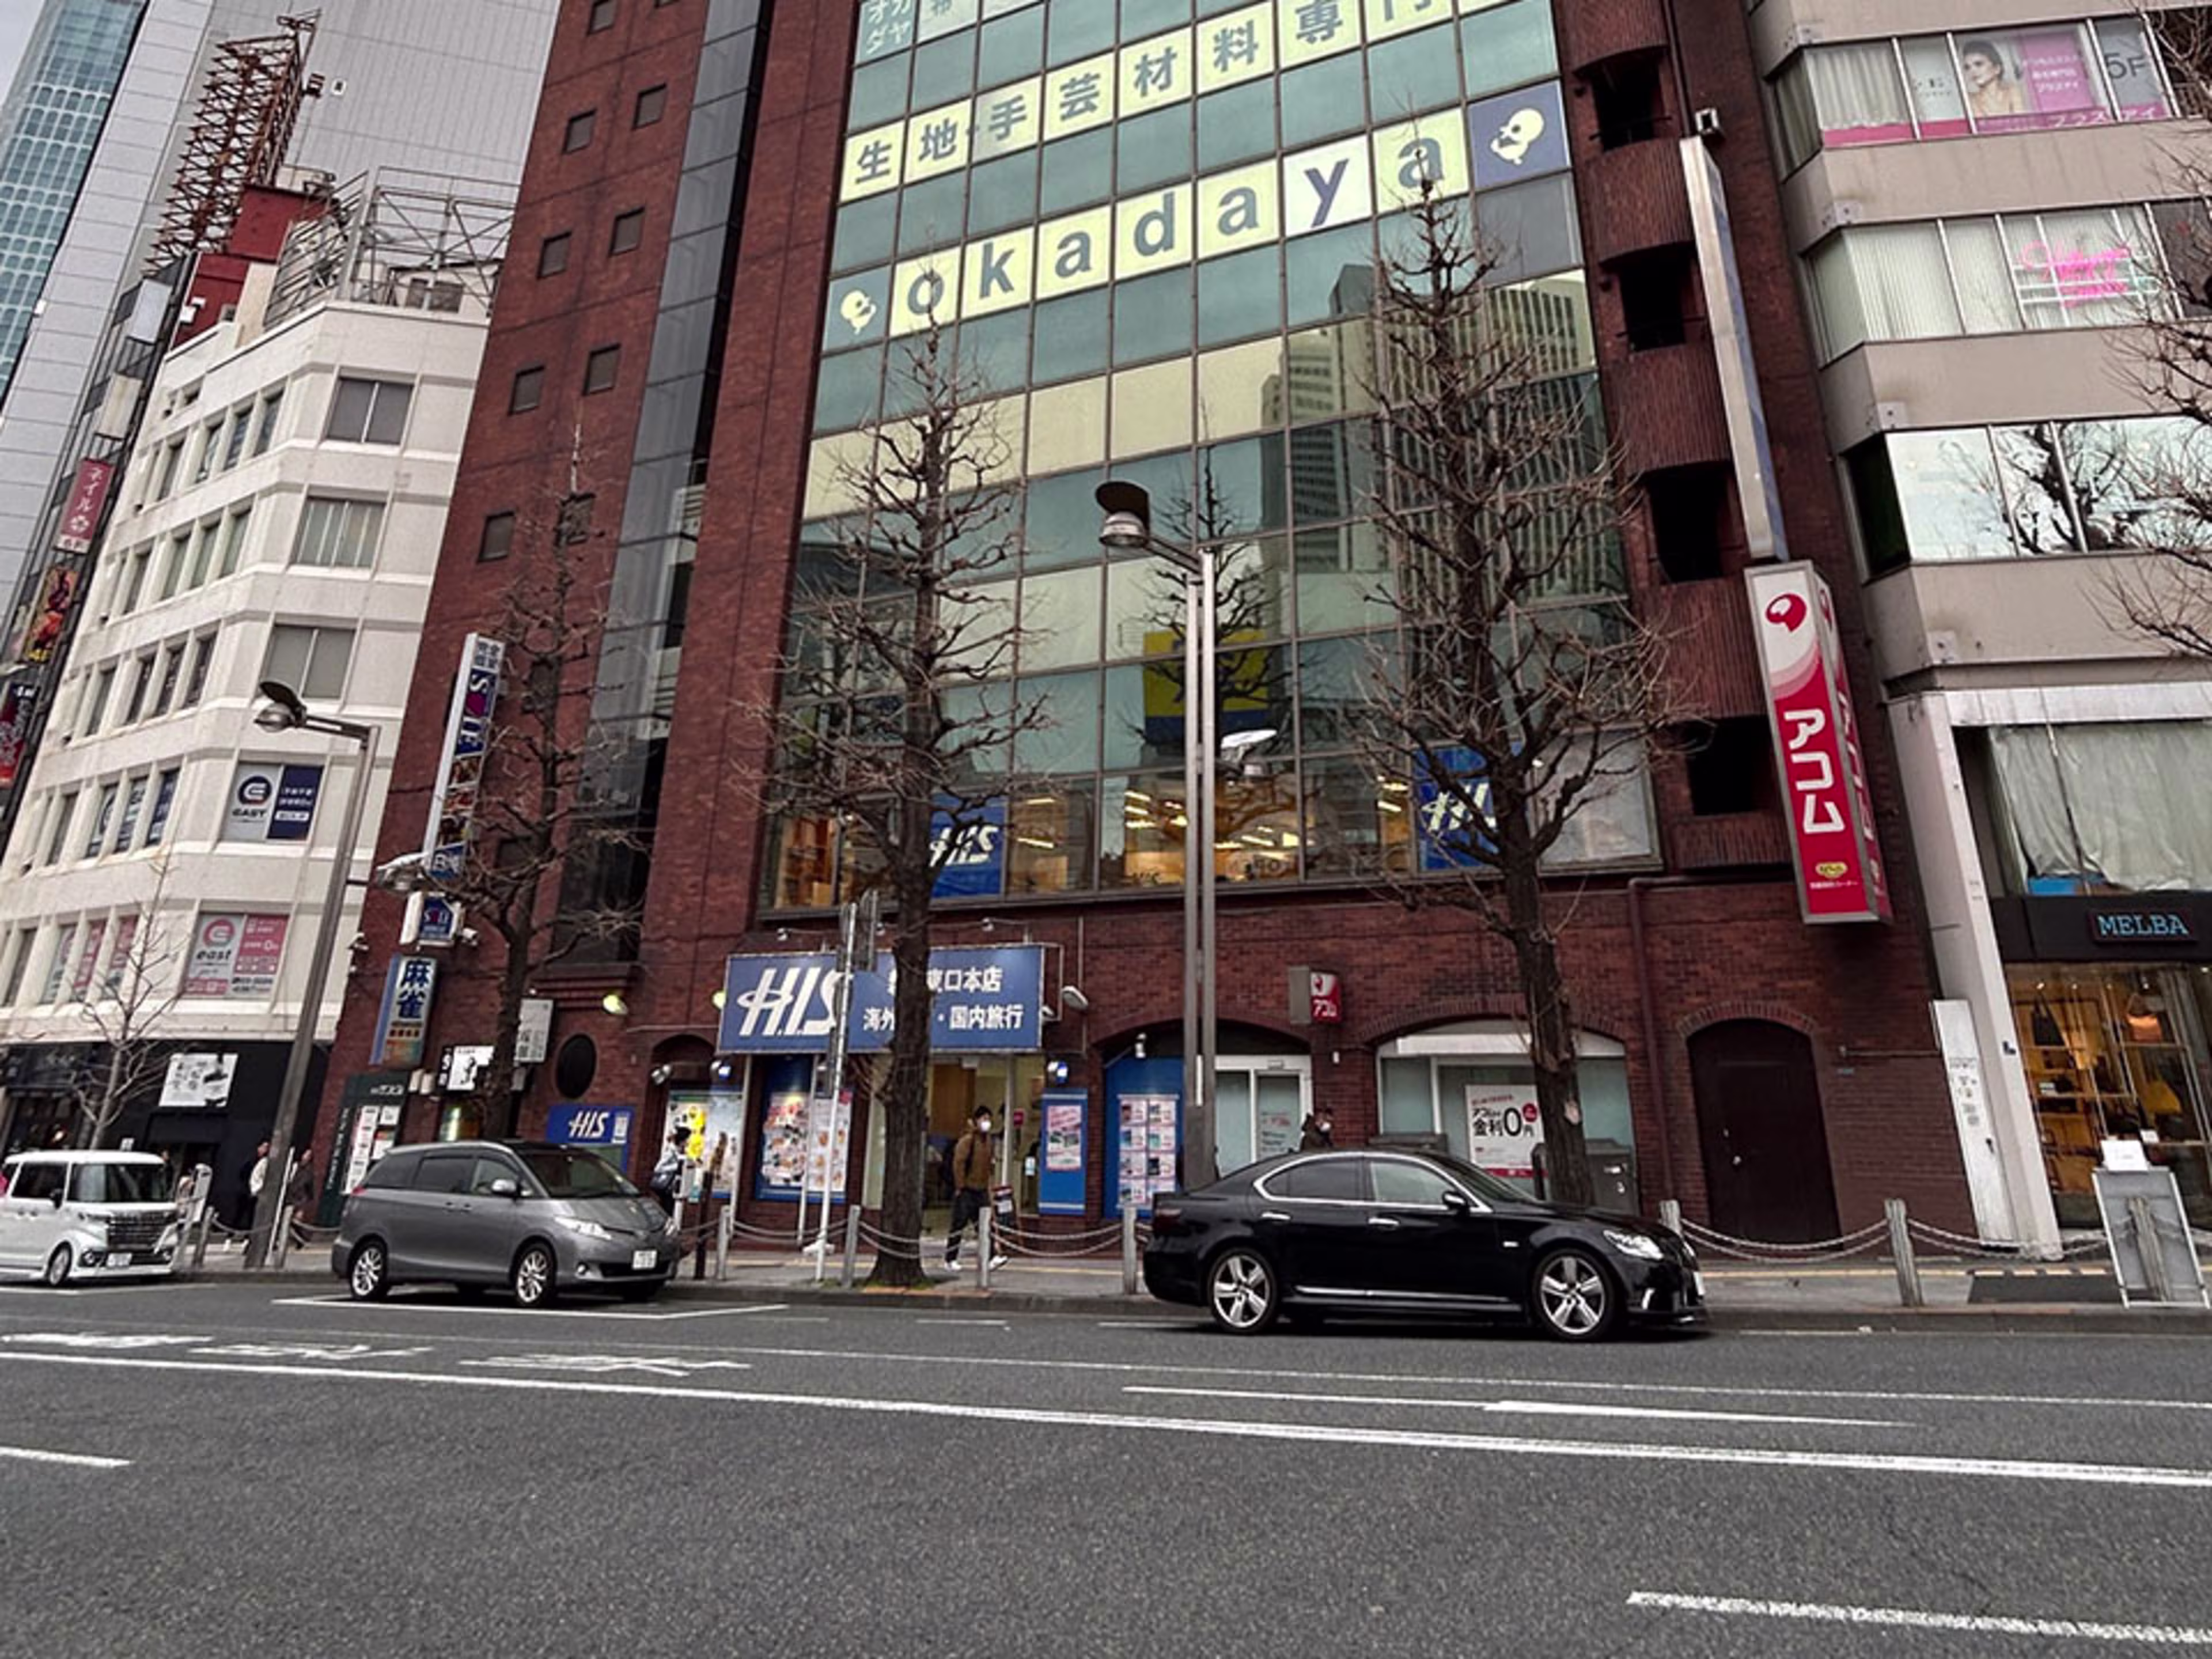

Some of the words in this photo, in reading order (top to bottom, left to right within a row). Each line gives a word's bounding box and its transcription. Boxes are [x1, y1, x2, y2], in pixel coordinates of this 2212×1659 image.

[907, 137, 1445, 316] okadaya
[1783, 708, 1846, 835] アコム
[2097, 914, 2190, 936] MELBA
[396, 959, 433, 1018] 麻雀
[568, 1111, 610, 1138] HIS
